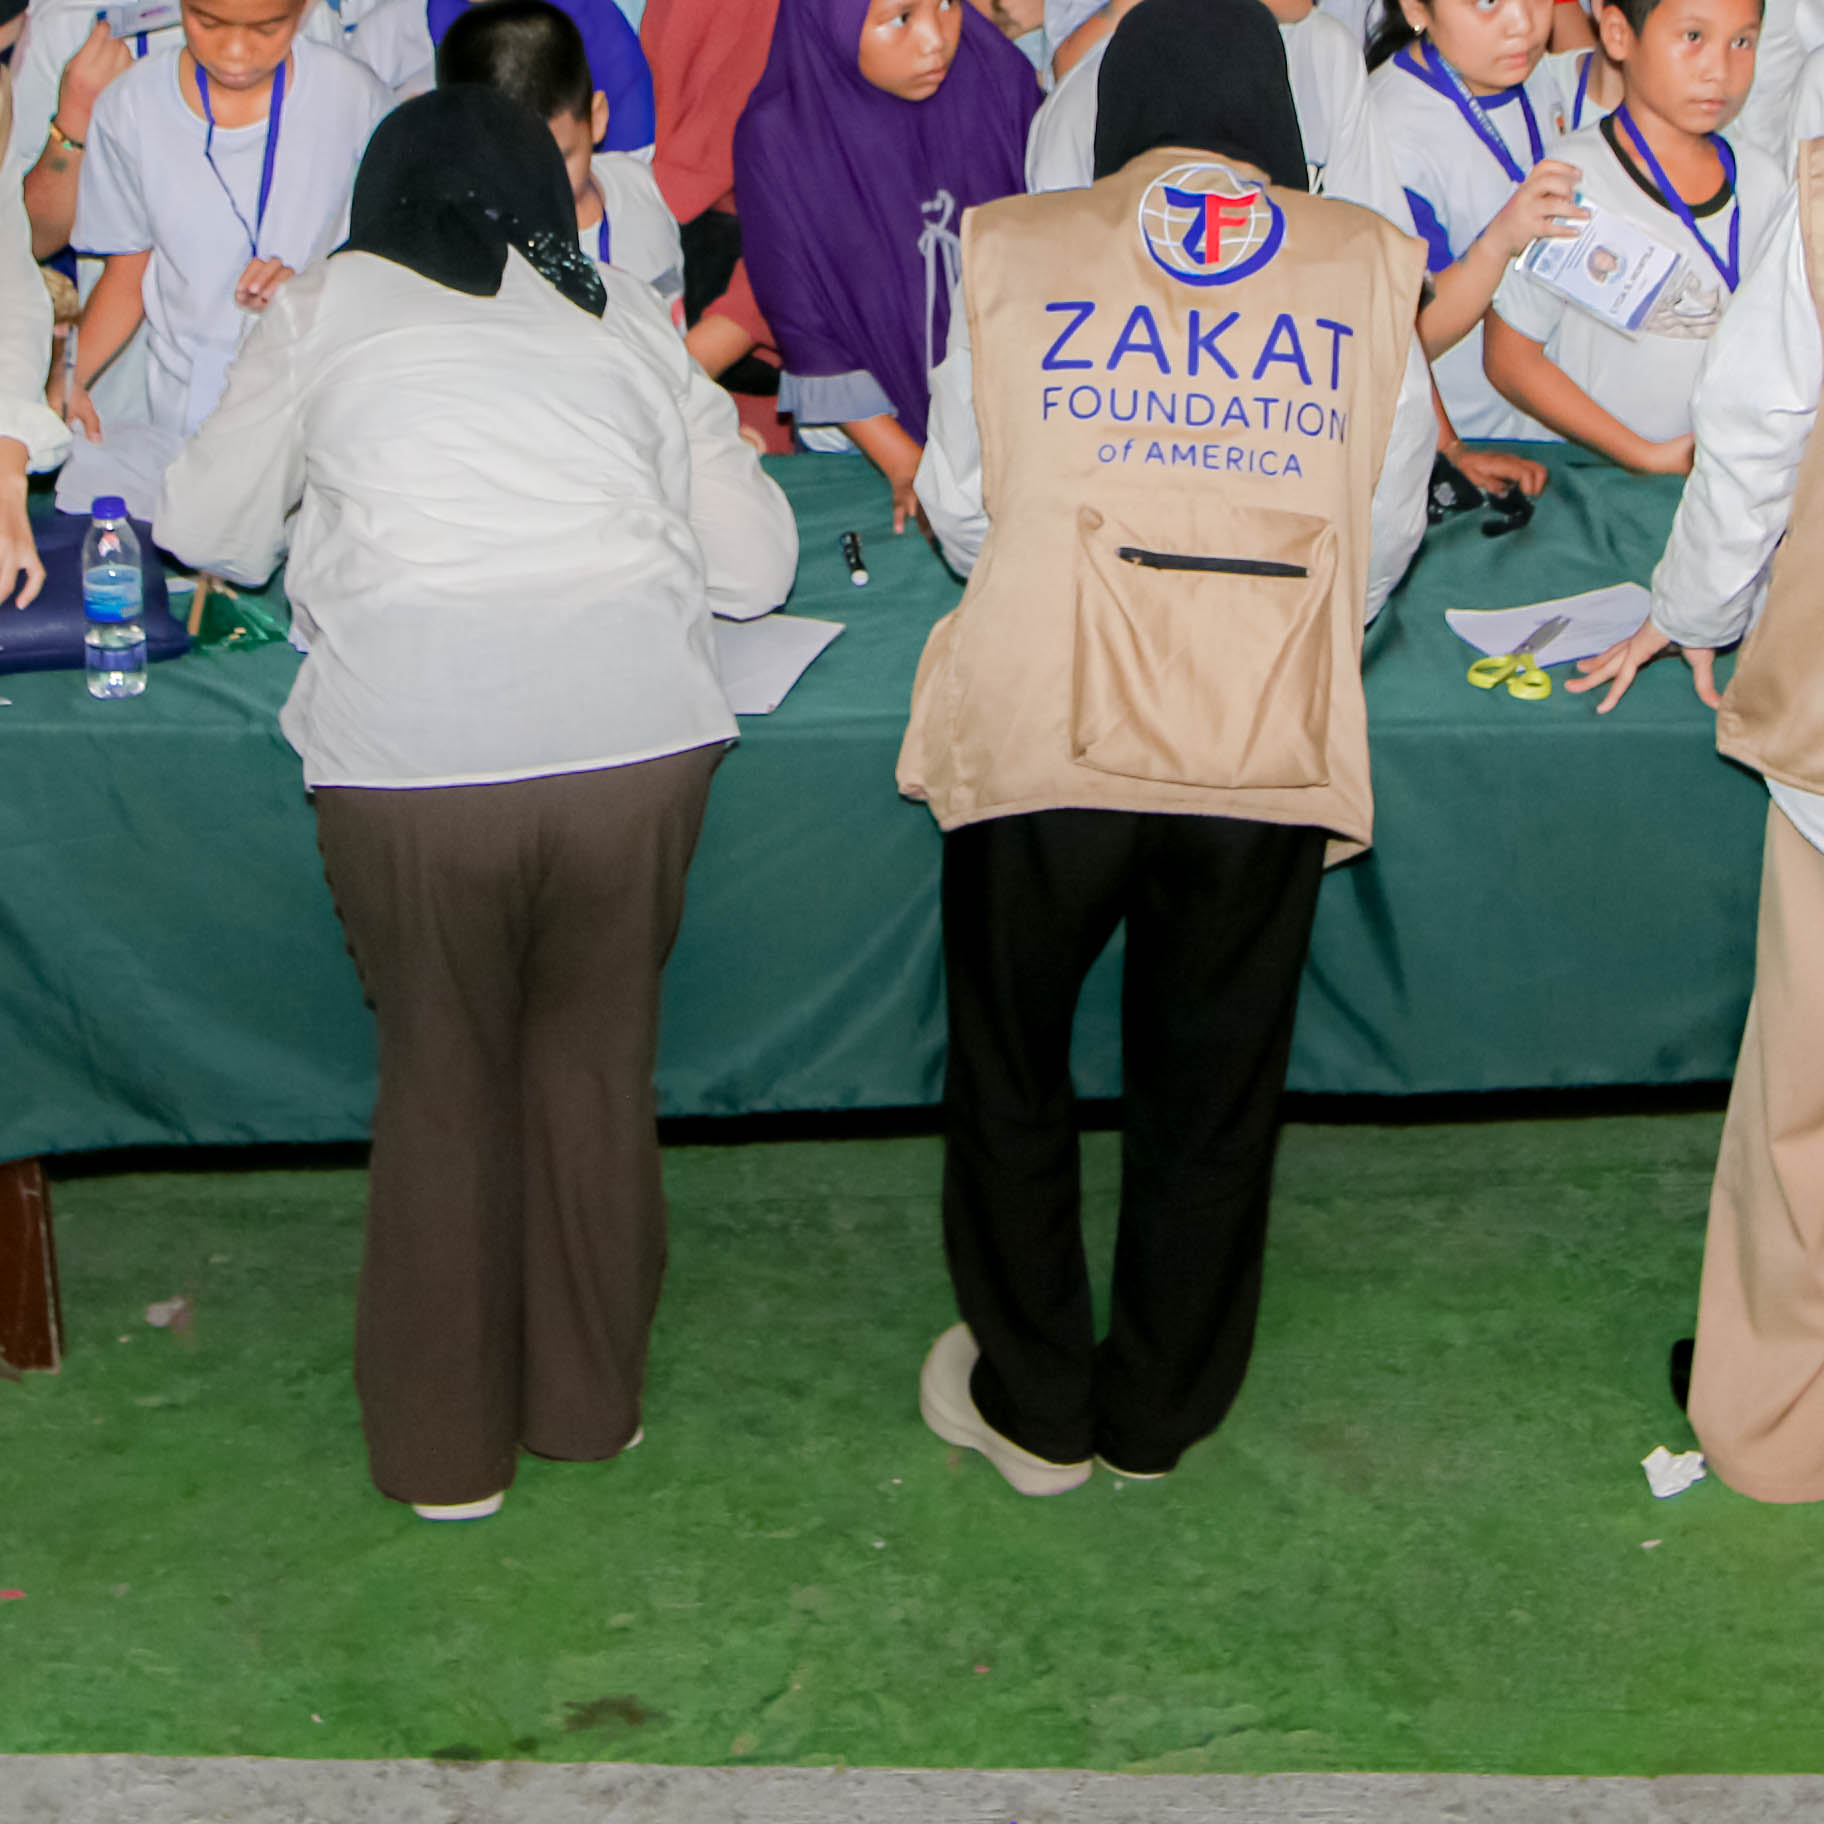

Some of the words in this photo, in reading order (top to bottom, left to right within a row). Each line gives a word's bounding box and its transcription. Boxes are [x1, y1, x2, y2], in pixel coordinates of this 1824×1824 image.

[1041, 300, 1354, 390] ZAKAT
[1042, 385, 1347, 444] FOUNDATION
[1097, 438, 1136, 463] of
[1145, 441, 1303, 478] AMERICA
